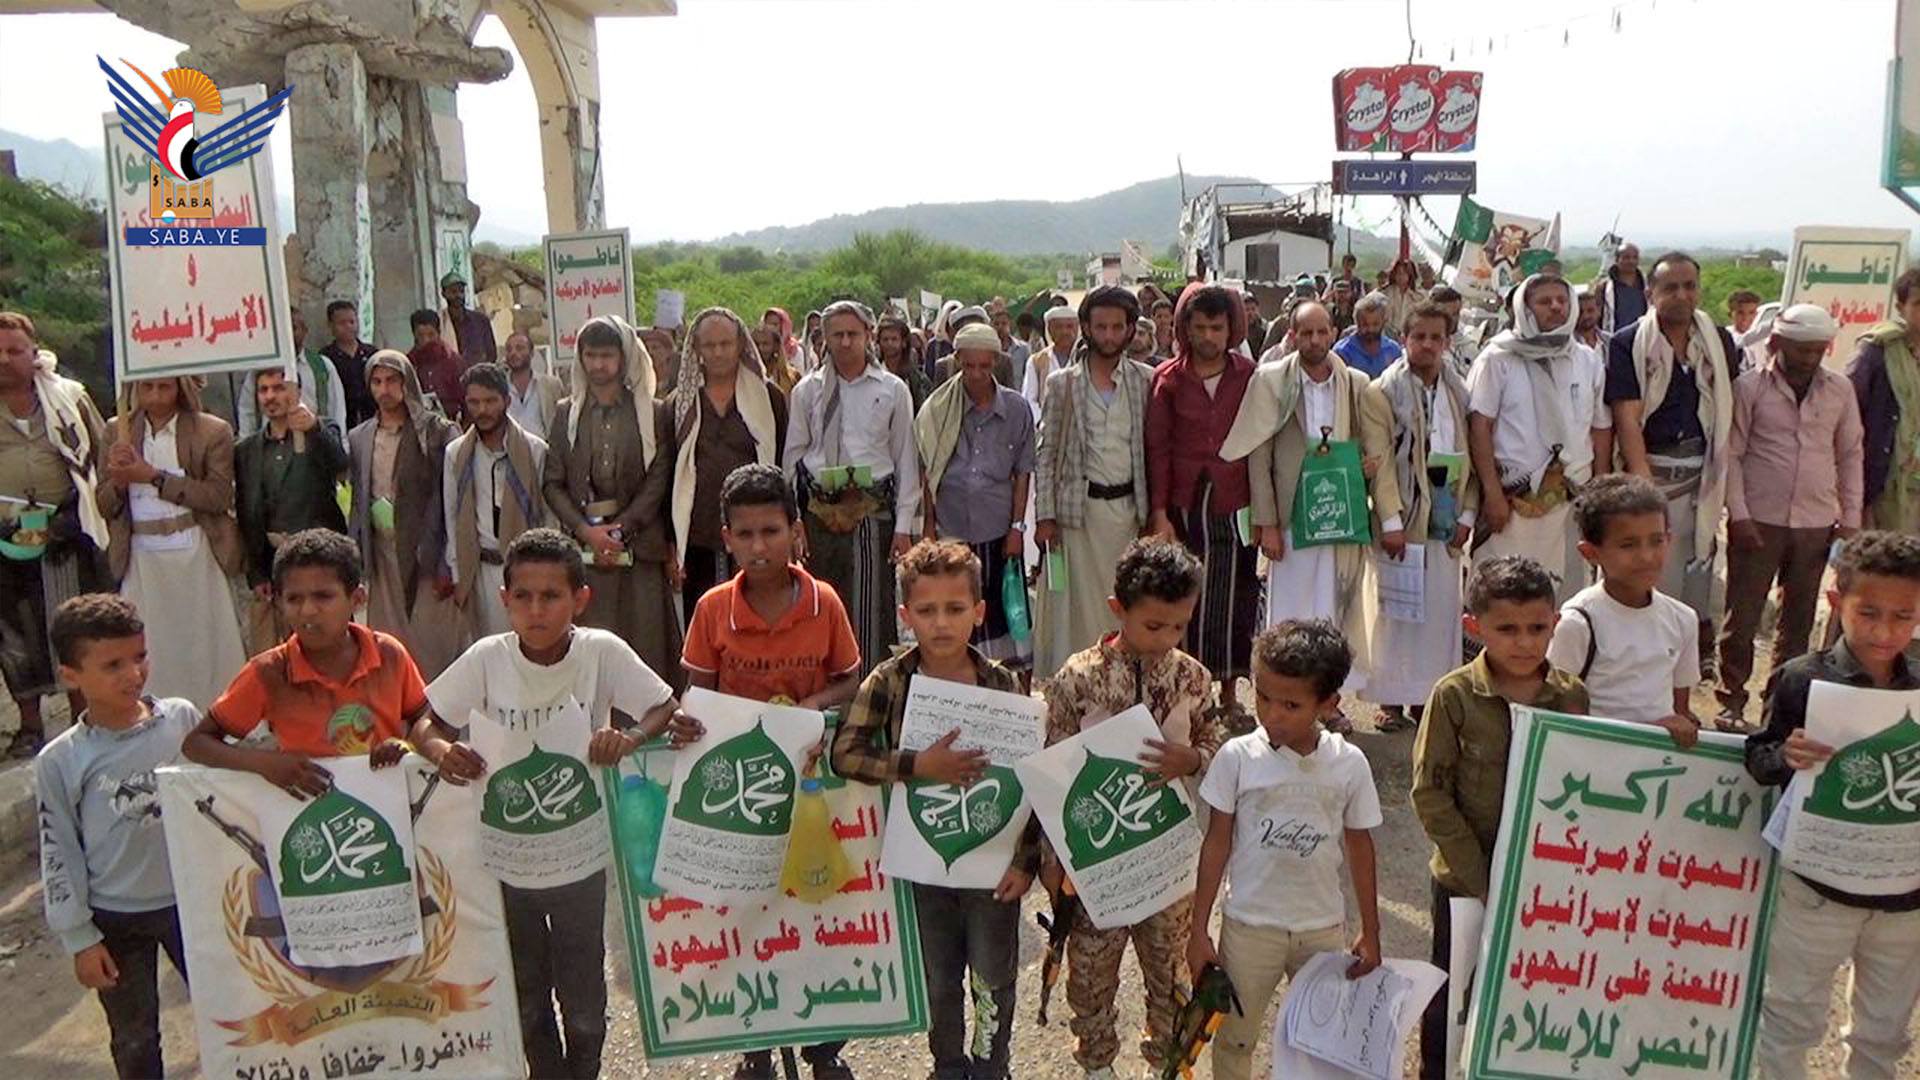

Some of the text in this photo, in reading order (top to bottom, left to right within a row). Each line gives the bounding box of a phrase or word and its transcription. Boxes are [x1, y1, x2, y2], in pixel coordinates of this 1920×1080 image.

[1346, 97, 1386, 122] Crystal
[1391, 95, 1431, 123] Crystal
[1437, 99, 1475, 123] Crystal
[1351, 169, 1397, 184] الراهدة
[188, 254, 197, 287] و
[553, 245, 621, 274] قاطعوا
[1800, 256, 1892, 291] قاطعوا
[131, 294, 267, 350] الإسرائيلية
[1538, 756, 1688, 822] أكبر
[1260, 818, 1329, 857] Vintage
[1532, 821, 1653, 876] لأمريكا
[1658, 850, 1761, 893] الموت
[1520, 885, 1750, 951] الموت لإسرائيل
[653, 909, 892, 973] اللعنة على اليهود
[661, 956, 898, 1036] النصر للإسلام
[1509, 948, 1741, 1010] اللعنة على اليهود
[1496, 999, 1729, 1077] النصر للإسلام
